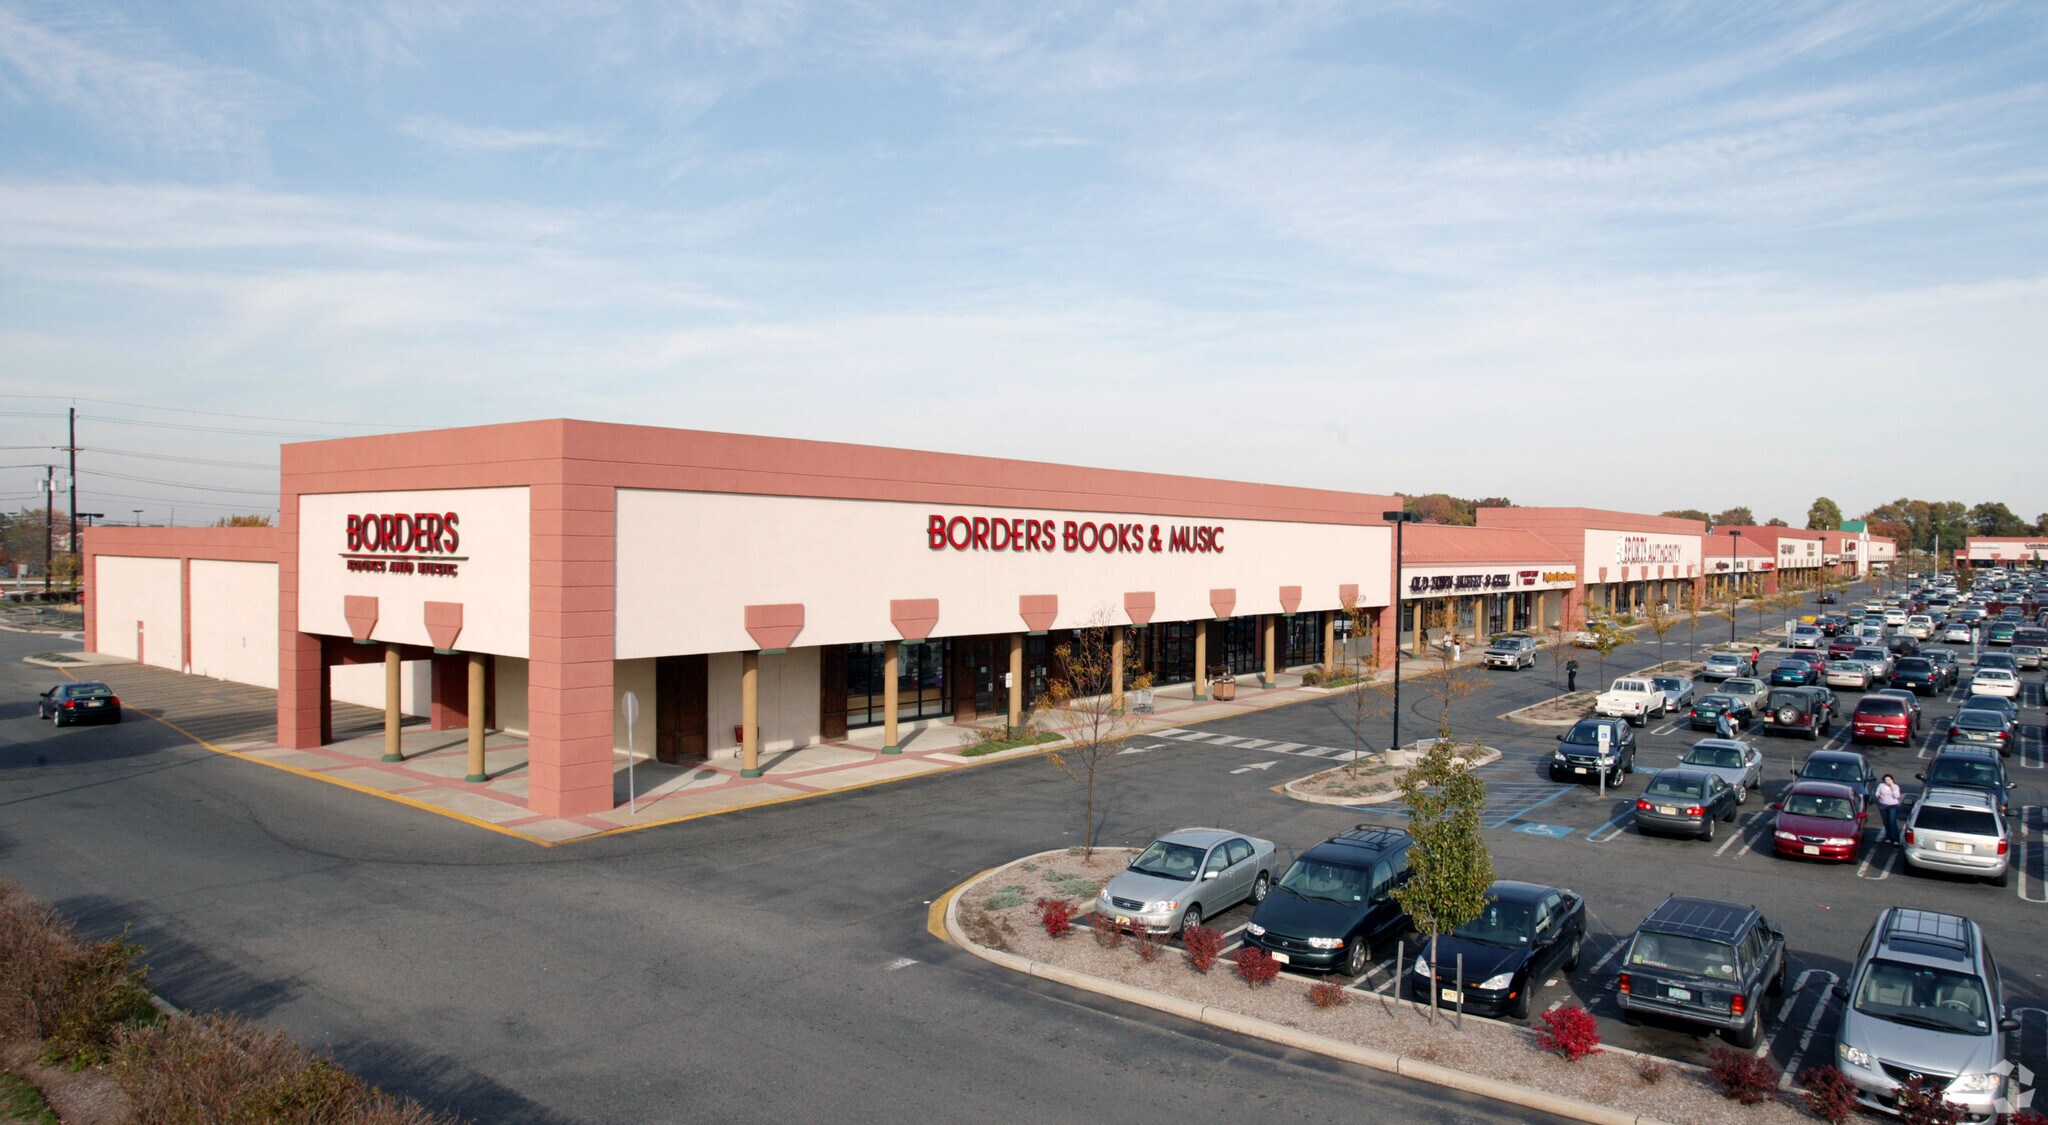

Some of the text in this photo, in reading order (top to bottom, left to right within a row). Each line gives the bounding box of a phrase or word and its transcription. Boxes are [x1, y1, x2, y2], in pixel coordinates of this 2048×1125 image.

[346, 512, 460, 553] BORDERS
[926, 514, 1225, 554] BORDERS BOOKS & MUSIC
[1648, 543, 1681, 562] AUTHORITY
[347, 559, 459, 578] BOOKS AND MUSIC
[1409, 576, 1429, 592] OLD
